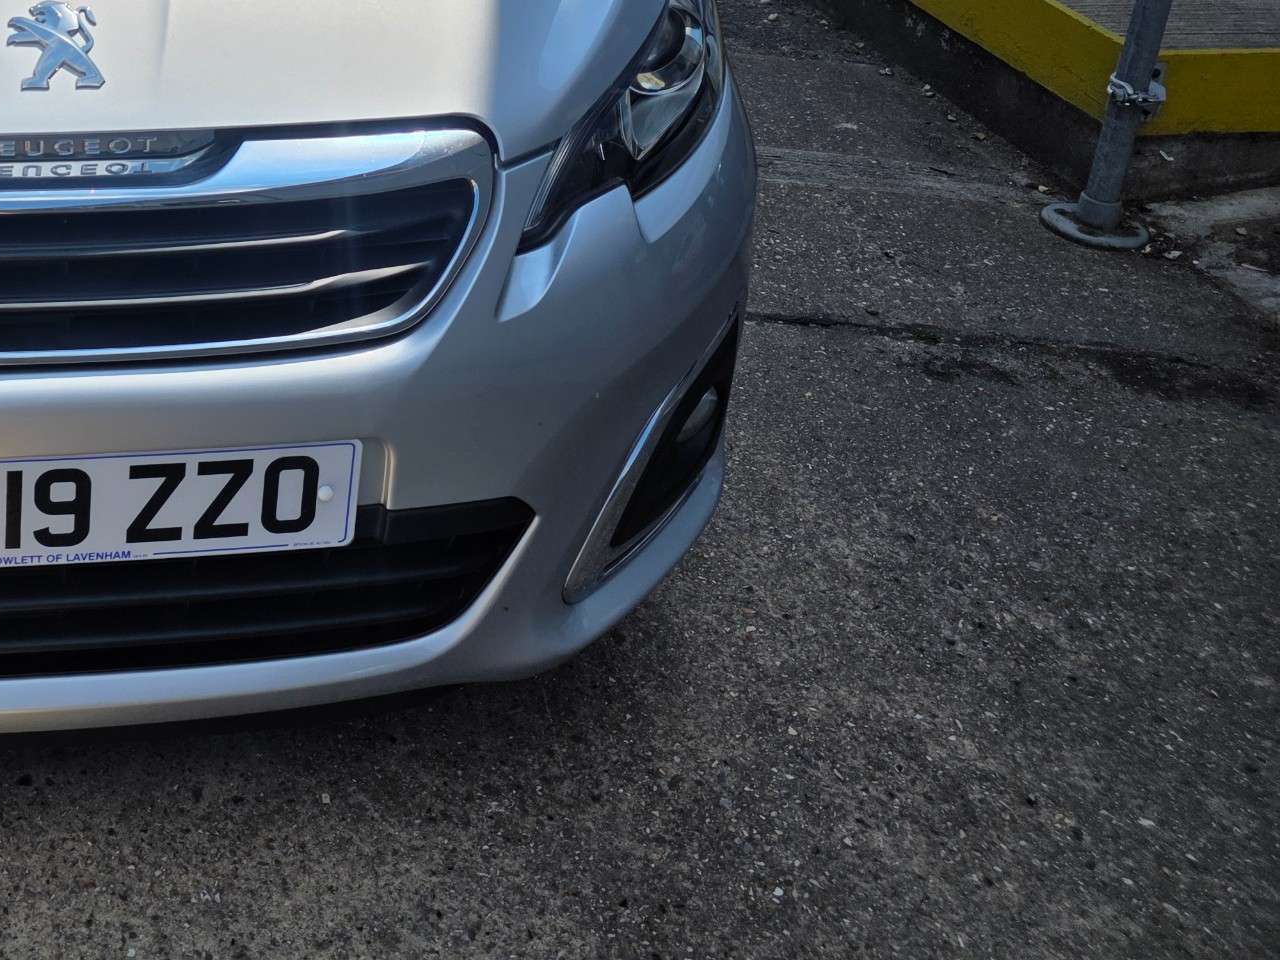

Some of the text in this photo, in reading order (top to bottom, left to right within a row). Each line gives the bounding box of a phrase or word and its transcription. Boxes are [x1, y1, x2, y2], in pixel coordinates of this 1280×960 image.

[126, 455, 321, 544] ZZO
[46, 554, 62, 563] OF
[66, 550, 131, 562] LAVENHAM
